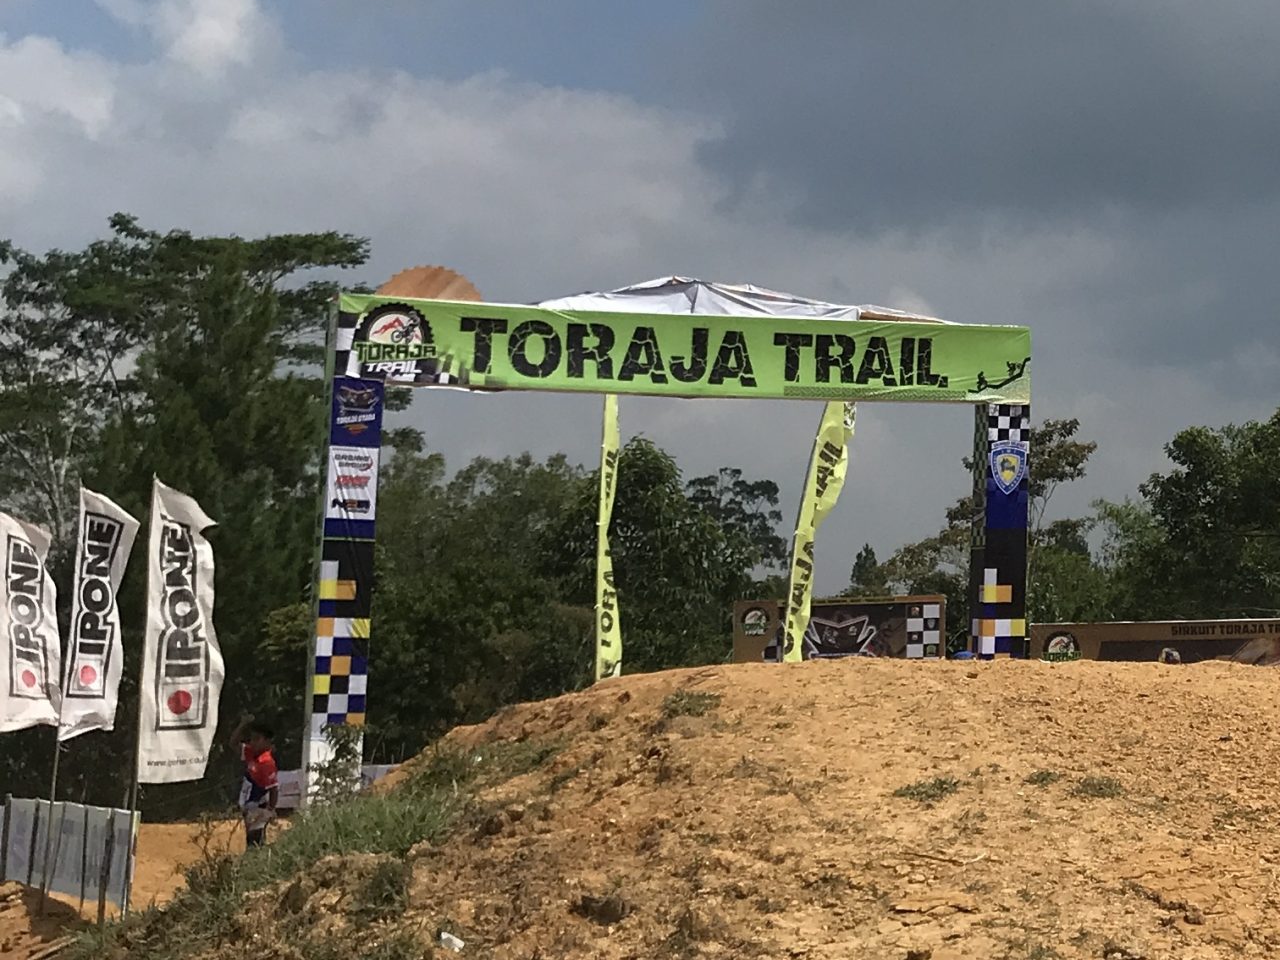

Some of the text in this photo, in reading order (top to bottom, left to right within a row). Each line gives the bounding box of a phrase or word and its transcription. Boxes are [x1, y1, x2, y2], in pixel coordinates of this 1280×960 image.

[353, 341, 438, 363] TORAJA
[364, 360, 423, 374] TRAIL
[459, 316, 949, 389] TORAJA TRAIL
[9, 541, 43, 664] IPONE
[76, 518, 117, 656] IPONE
[162, 522, 203, 678] IPONE
[1171, 623, 1216, 636] SIRKUIT
[1219, 623, 1266, 635] TORAJA
